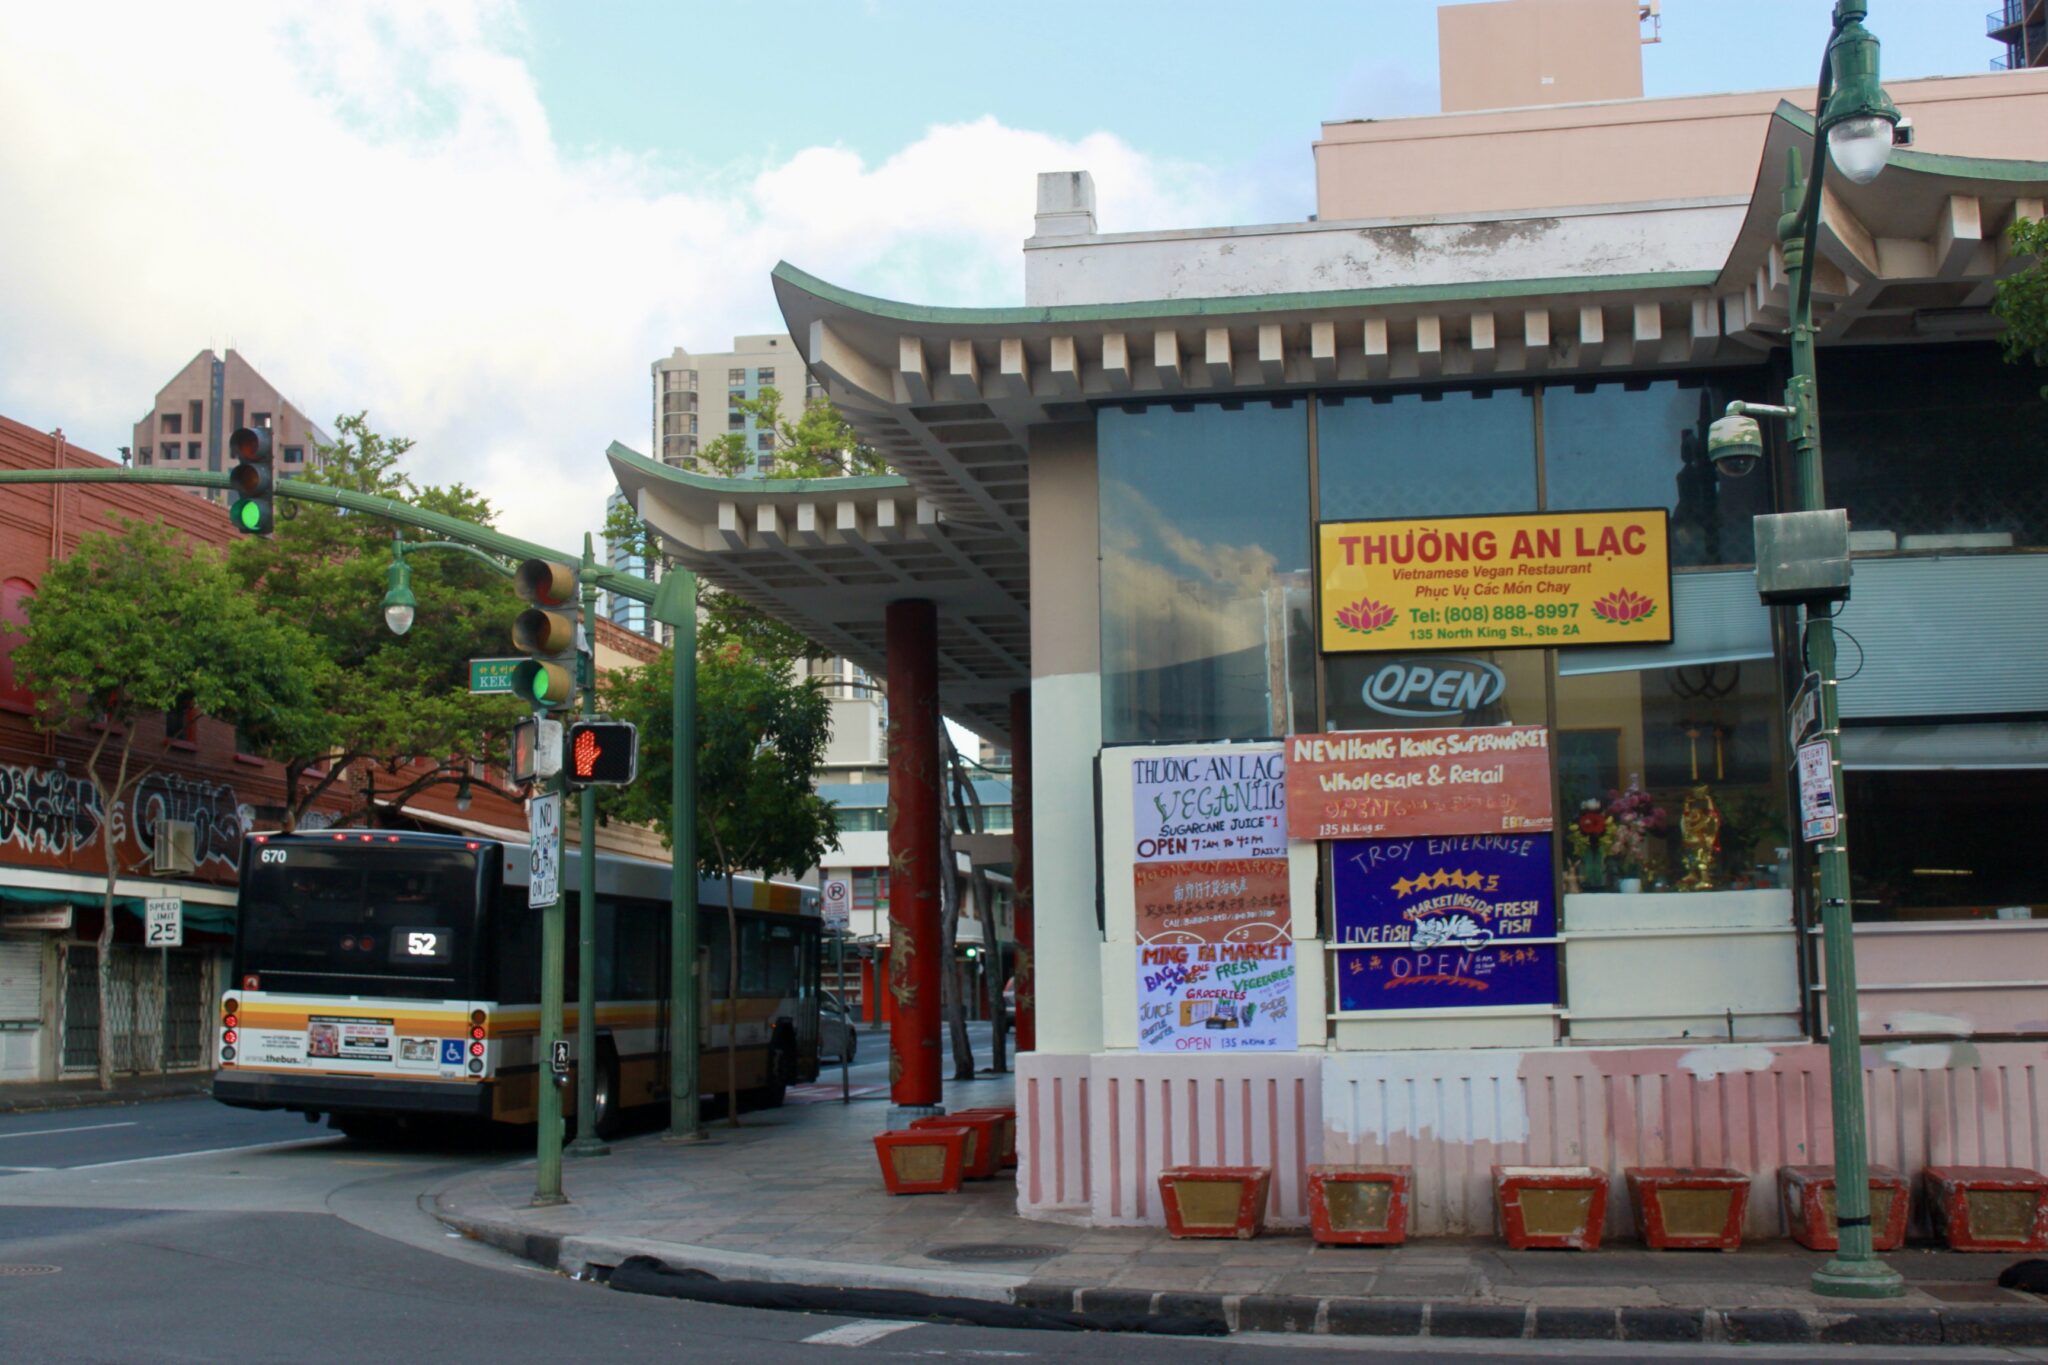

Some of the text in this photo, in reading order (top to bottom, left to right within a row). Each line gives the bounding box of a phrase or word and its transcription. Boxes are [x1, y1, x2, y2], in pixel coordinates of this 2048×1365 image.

[1510, 528, 1561, 559] AN
[1575, 524, 1647, 561] LẠC
[1392, 562, 1592, 580] Vietnamese Vegan Restaurant
[1415, 580, 1571, 601] Phục Vụ Các Món Chay
[1409, 603, 1580, 624] Tel: (808) 888-8997
[1409, 629, 1433, 640] 135
[1437, 627, 1473, 640] North
[1477, 626, 1506, 640] King
[1536, 625, 1559, 636] Ste
[1563, 624, 1580, 635] 2A
[480, 675, 512, 687] KEK
[1371, 664, 1491, 710] OPEN
[1294, 739, 1346, 762] NEW
[1204, 756, 1233, 782] AN
[1319, 763, 1504, 792] Wholesale & Retail
[540, 803, 552, 829] NO
[1158, 820, 1225, 837] SUGARCANE
[1230, 816, 1265, 831] JUICE
[1501, 815, 1524, 829] EBT
[1319, 824, 1339, 836] 135
[261, 849, 287, 863] 670
[1137, 837, 1188, 858] OPEN
[1350, 836, 1534, 874] TROY ENTERPRISE
[149, 902, 179, 911] SPEED
[1405, 892, 1494, 919] MARKET INSIDE
[1495, 901, 1538, 918] FRESH
[150, 922, 176, 942] 25
[1346, 924, 1411, 943] LIVE FISH
[1499, 918, 1531, 935] FISH
[408, 932, 437, 955] 52
[1141, 945, 1189, 966] MING
[1220, 942, 1292, 962] MARKET
[1215, 960, 1259, 981] FRESH
[1391, 953, 1474, 978] OPEN
[1186, 988, 1247, 1000] GROCERIES
[1140, 1002, 1174, 1022] JUICE
[1175, 1037, 1212, 1050] OPEN
[1221, 1037, 1237, 1049] 135
